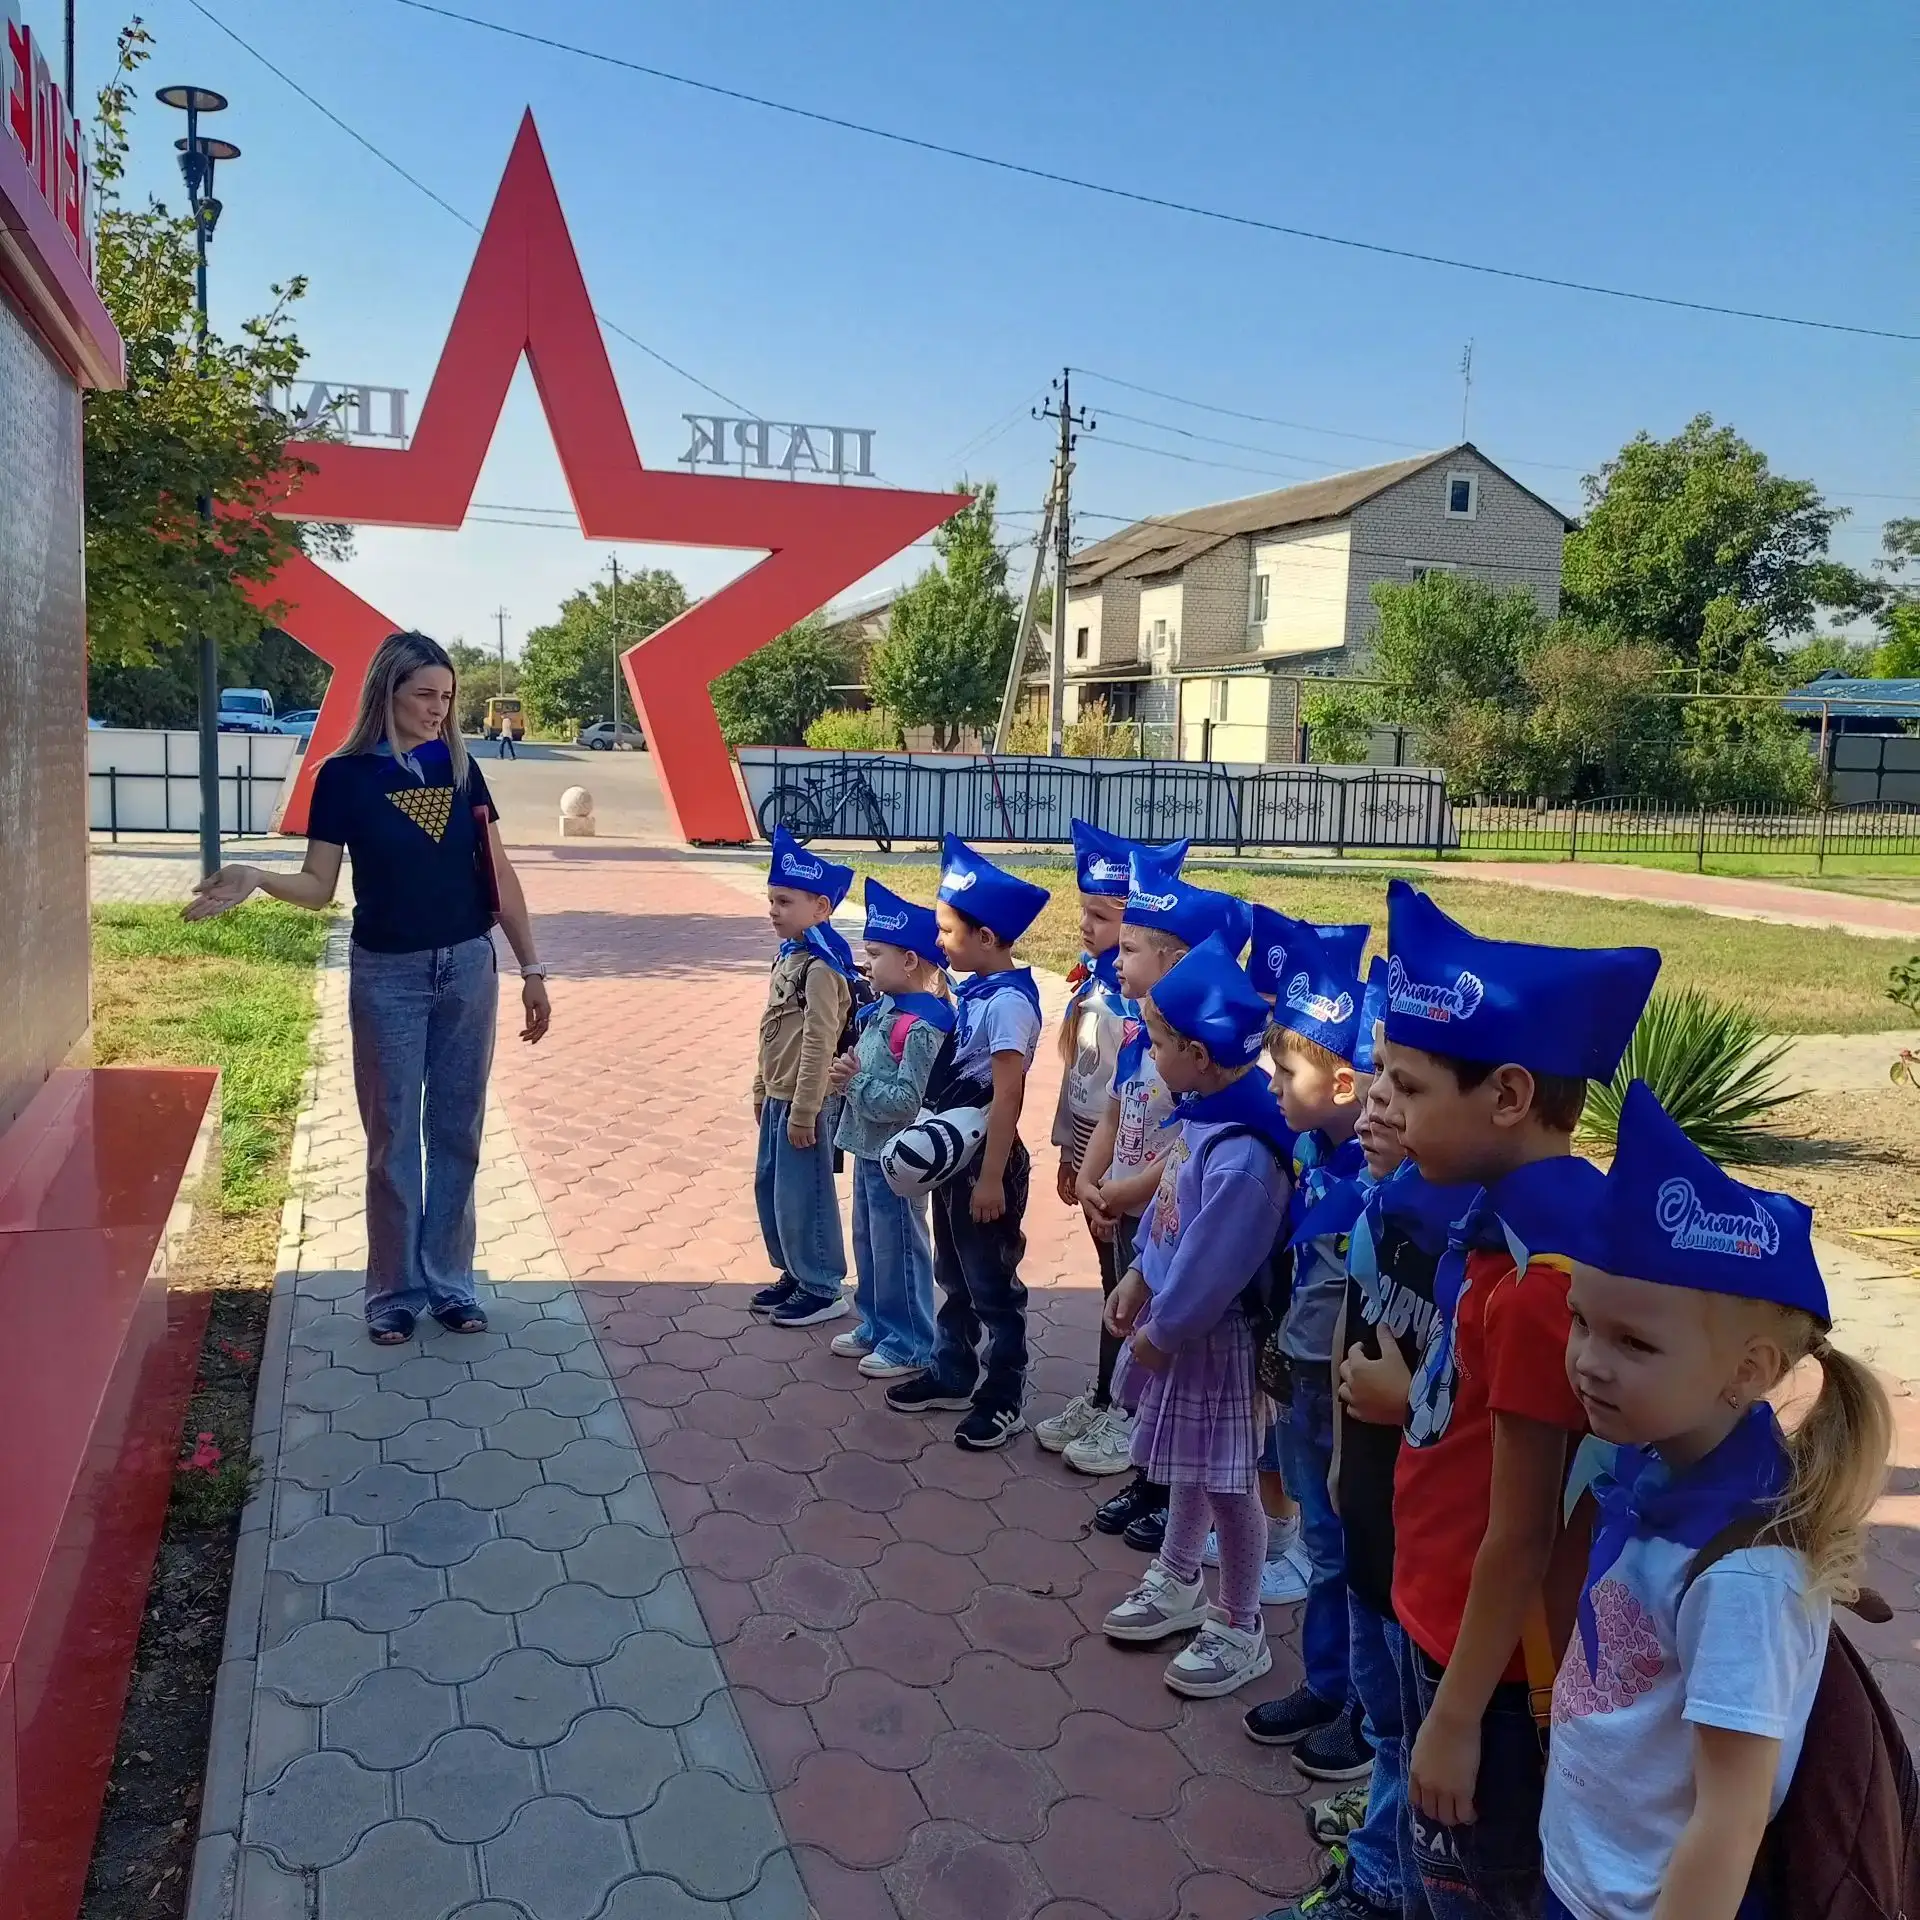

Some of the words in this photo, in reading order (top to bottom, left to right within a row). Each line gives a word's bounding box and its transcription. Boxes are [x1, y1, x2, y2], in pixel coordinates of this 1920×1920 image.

[1388, 955, 1461, 1010] Орлята
[1657, 1178, 1768, 1245] Орлята
[1673, 1231, 1761, 1258] ДОШКОЛЯТА
[1562, 1767, 1585, 1787] CHILD
